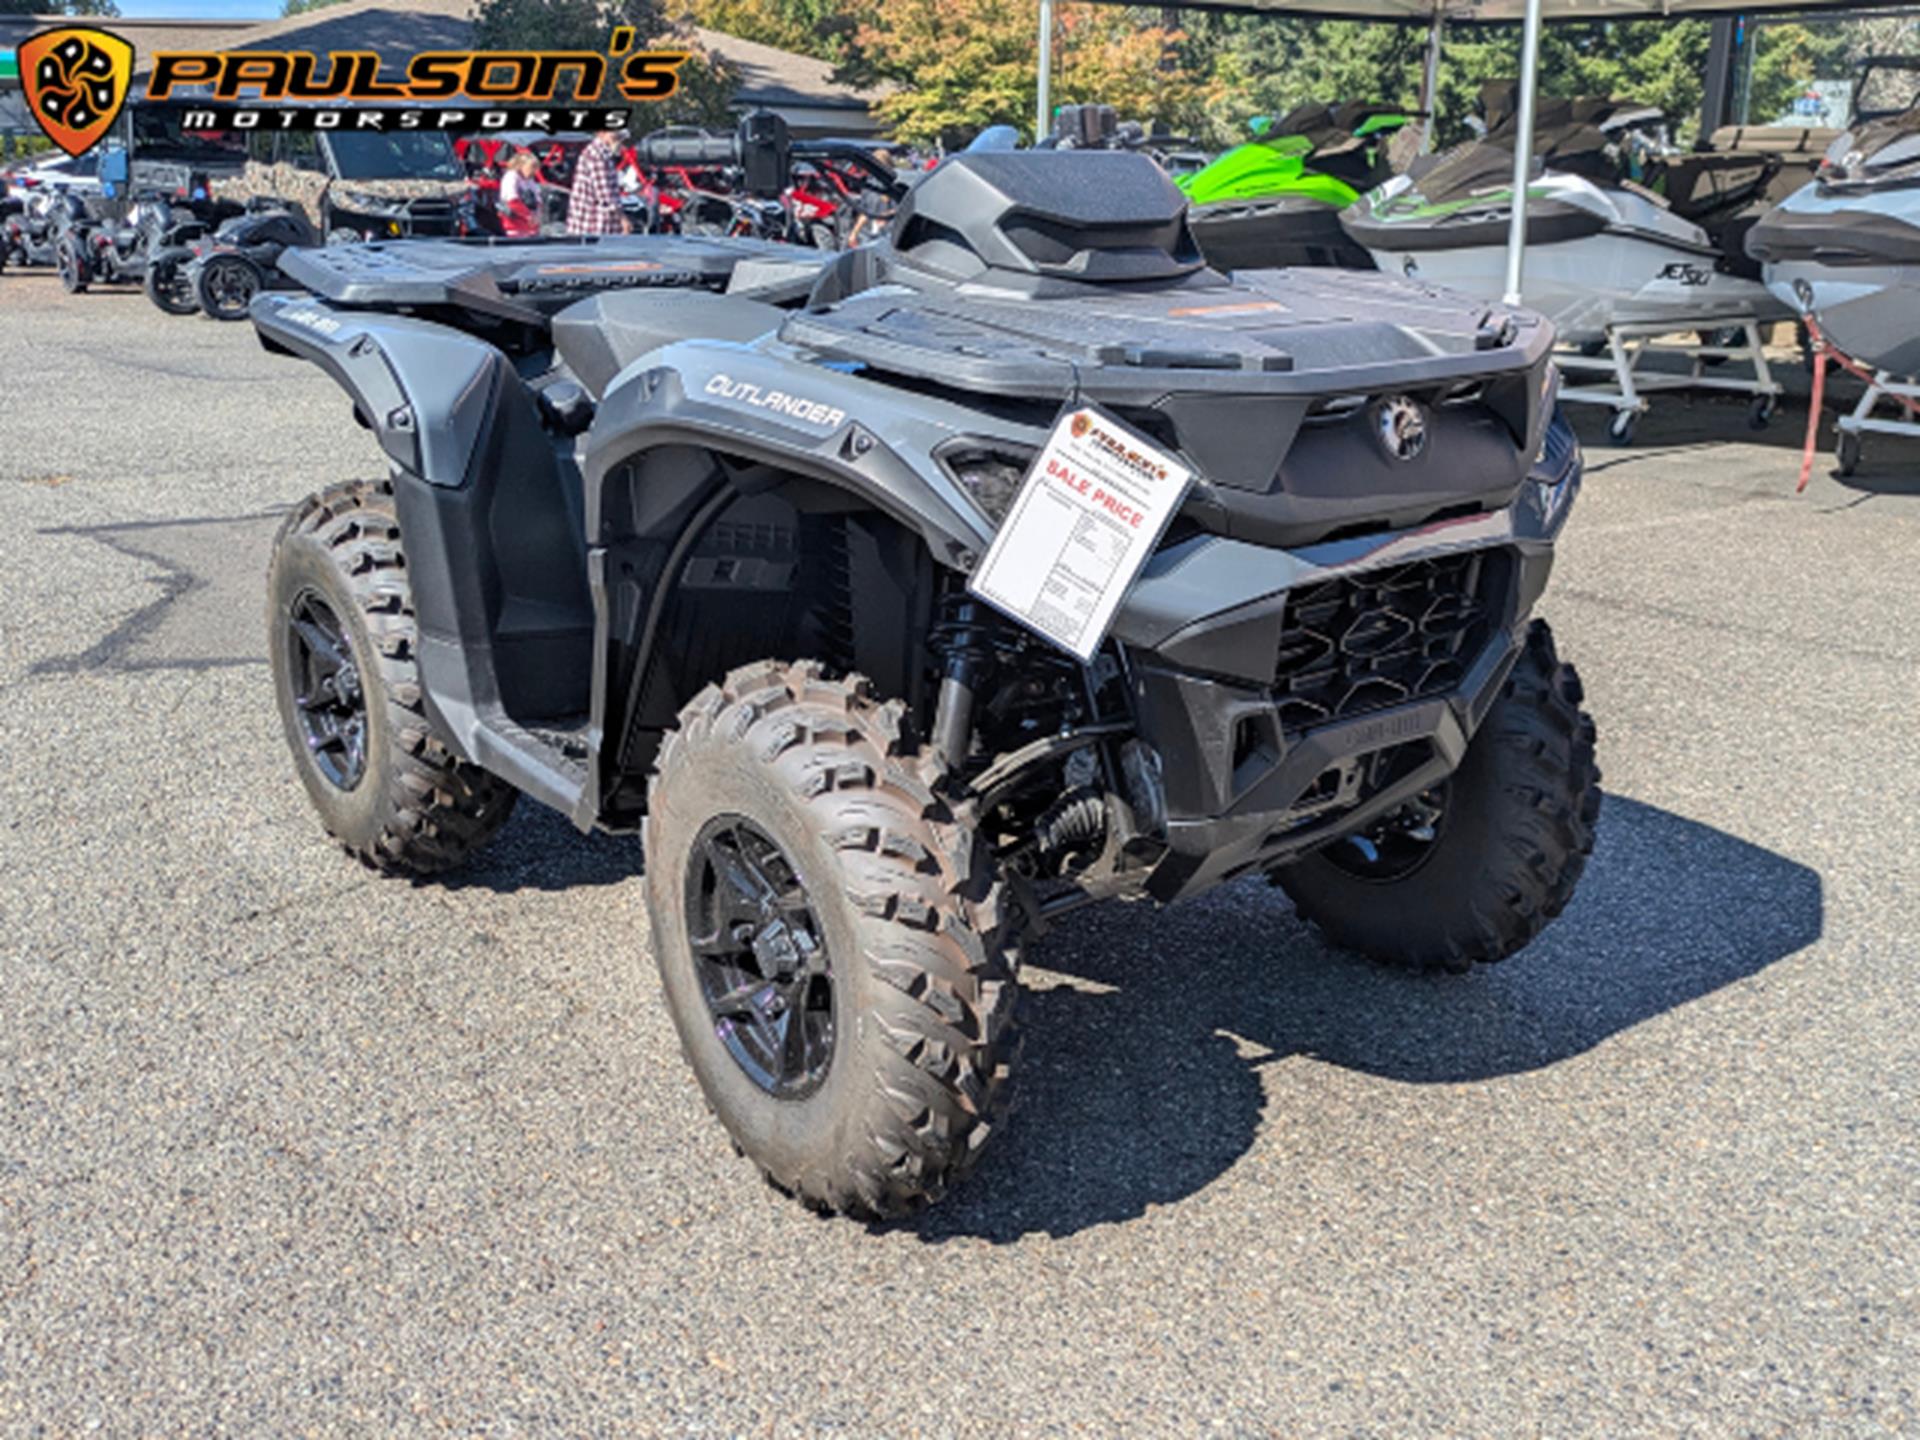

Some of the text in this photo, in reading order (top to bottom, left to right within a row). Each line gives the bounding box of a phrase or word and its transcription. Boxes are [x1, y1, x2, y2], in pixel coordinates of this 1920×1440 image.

[704, 373, 846, 427] OUTLANDER
[1046, 459, 1092, 496] SALE
[1091, 488, 1145, 529] PRICE
